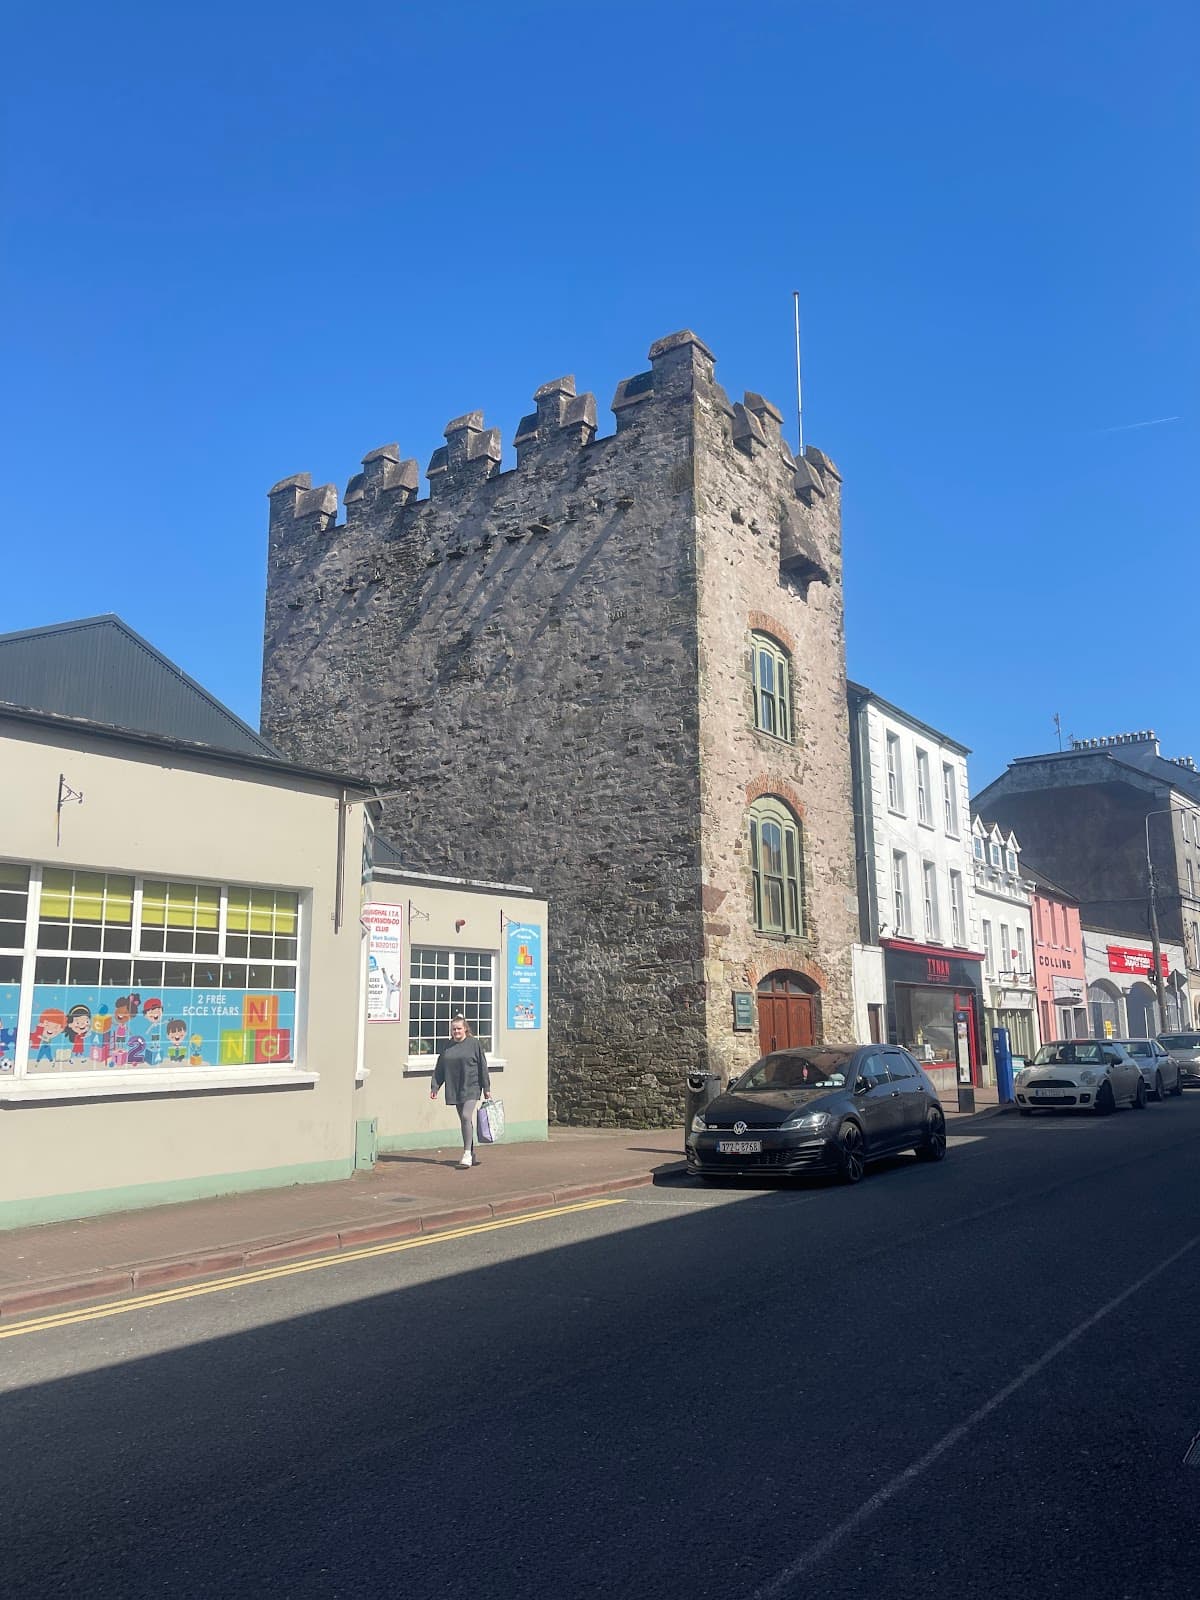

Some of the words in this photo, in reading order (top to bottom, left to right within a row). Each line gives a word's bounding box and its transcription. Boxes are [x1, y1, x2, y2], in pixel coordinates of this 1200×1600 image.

[927, 958, 950, 976] TYNAN
[1039, 955, 1072, 970] COLLINS
[197, 995, 204, 1005] 2
[205, 994, 227, 1005] FREE
[182, 1006, 209, 1016] ECCE
[210, 1006, 240, 1016] YEARS
[127, 1036, 146, 1064] 2
